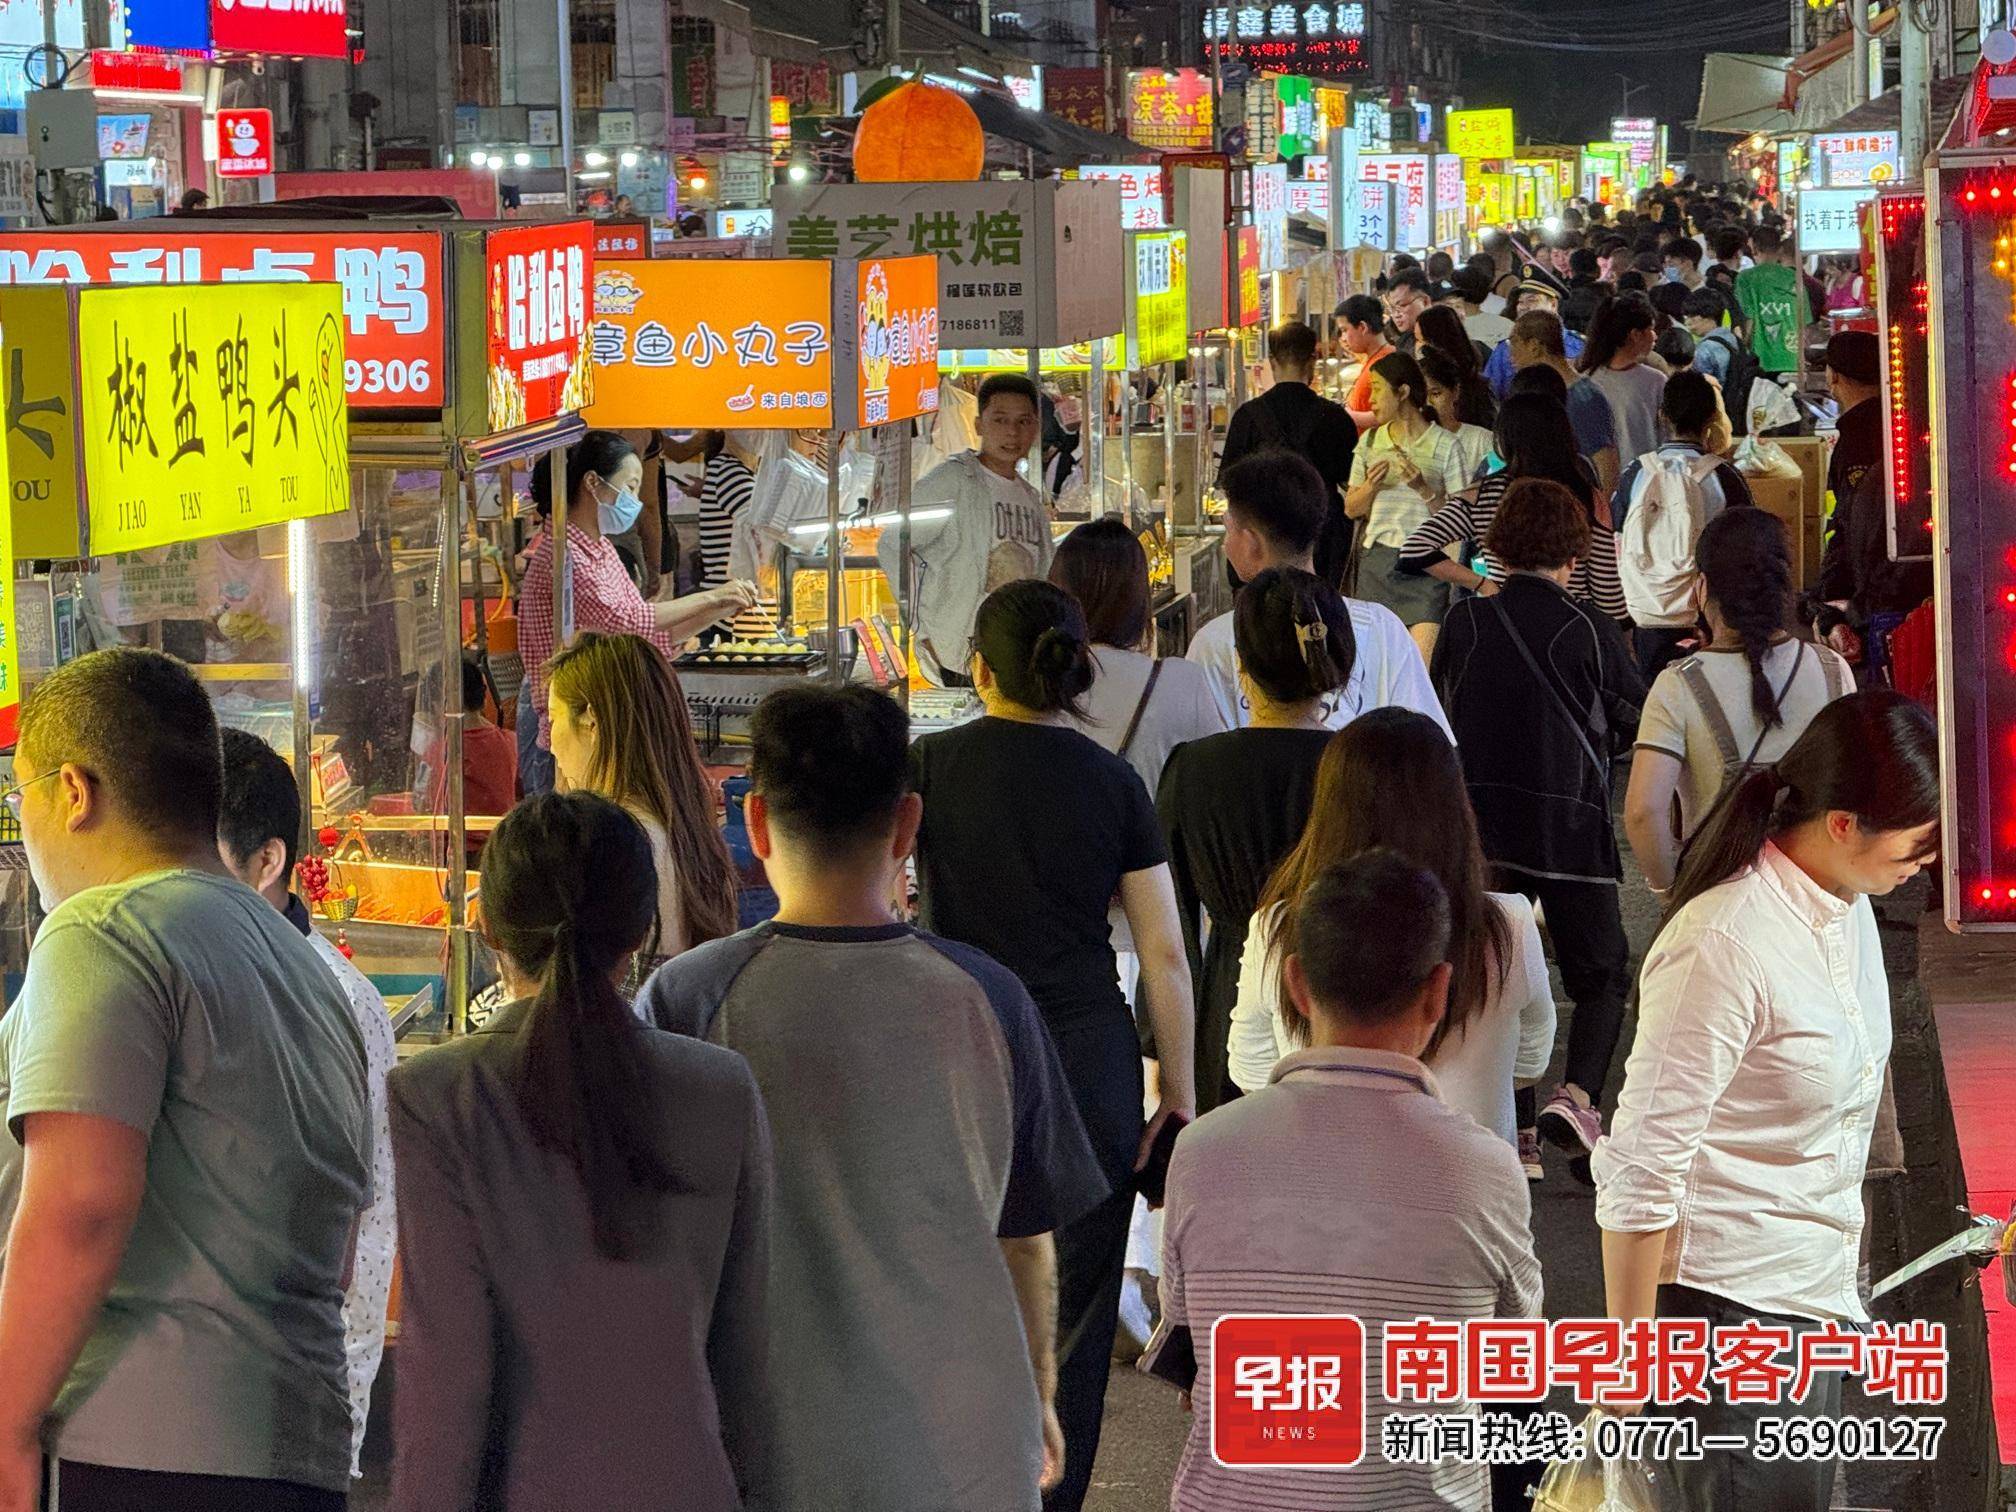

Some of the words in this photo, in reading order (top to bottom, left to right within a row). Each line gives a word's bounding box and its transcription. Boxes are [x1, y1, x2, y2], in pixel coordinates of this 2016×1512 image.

[508, 245, 584, 350] 哈利卤鸭
[592, 321, 828, 366] 章鱼小丸子
[107, 307, 301, 472] 椒盐鸭头
[118, 499, 147, 532] JIAO
[180, 491, 201, 521] YAN
[238, 486, 252, 513] YA
[280, 476, 299, 503] TOU
